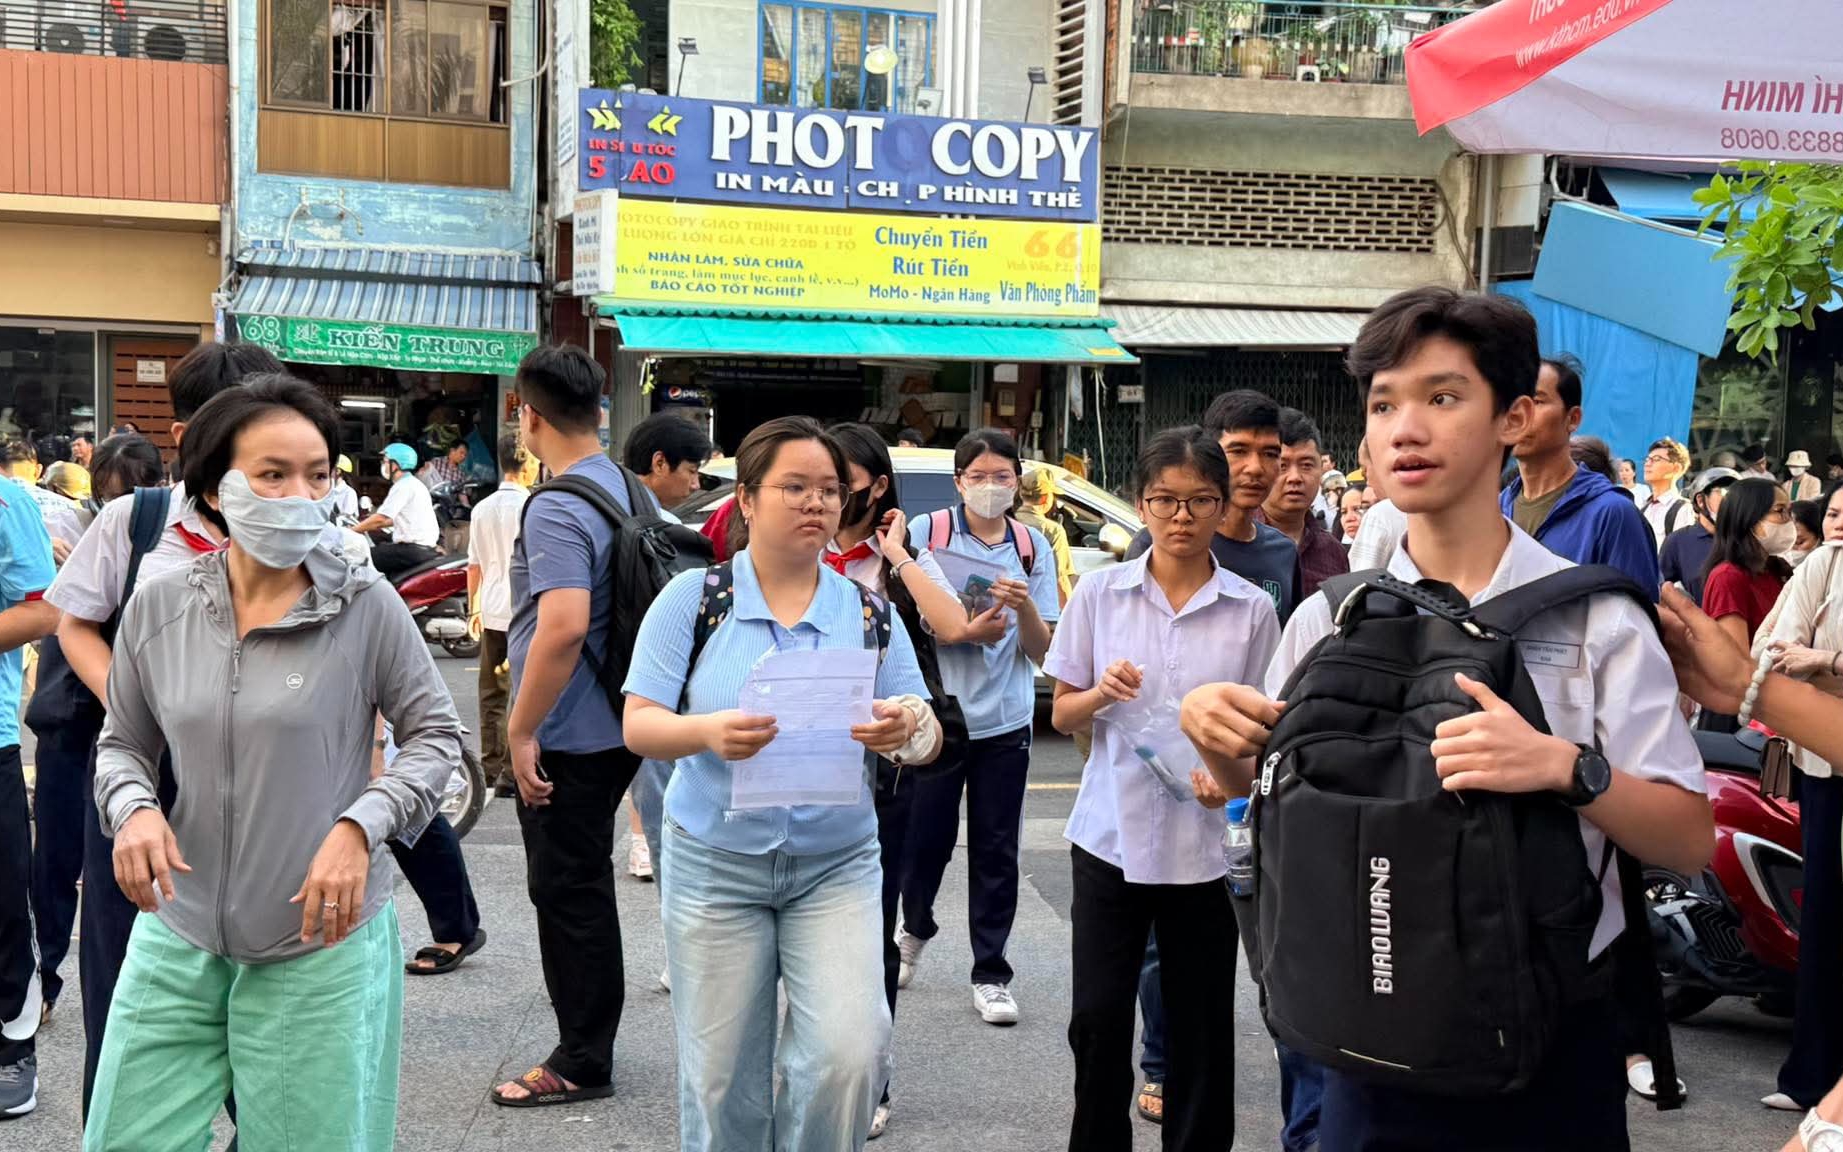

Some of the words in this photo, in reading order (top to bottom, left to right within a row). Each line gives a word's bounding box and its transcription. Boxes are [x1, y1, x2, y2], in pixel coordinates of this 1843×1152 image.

[588, 138, 607, 150] IN
[588, 155, 608, 178] 5
[621, 159, 676, 185] AO
[716, 171, 752, 191] IN
[761, 171, 835, 197] MÀU
[856, 179, 937, 205] CHP
[942, 181, 1019, 205] HÌNH
[1027, 186, 1084, 208] THẺ
[874, 226, 943, 250] Chuyển
[1024, 230, 1080, 259] 66
[892, 255, 925, 275] Rút
[868, 283, 910, 300] MoMo
[243, 315, 281, 342] 68
[327, 324, 401, 352] KIẾN
[408, 333, 505, 359] TRUNG
[1369, 856, 1394, 995] BIAOWANG
